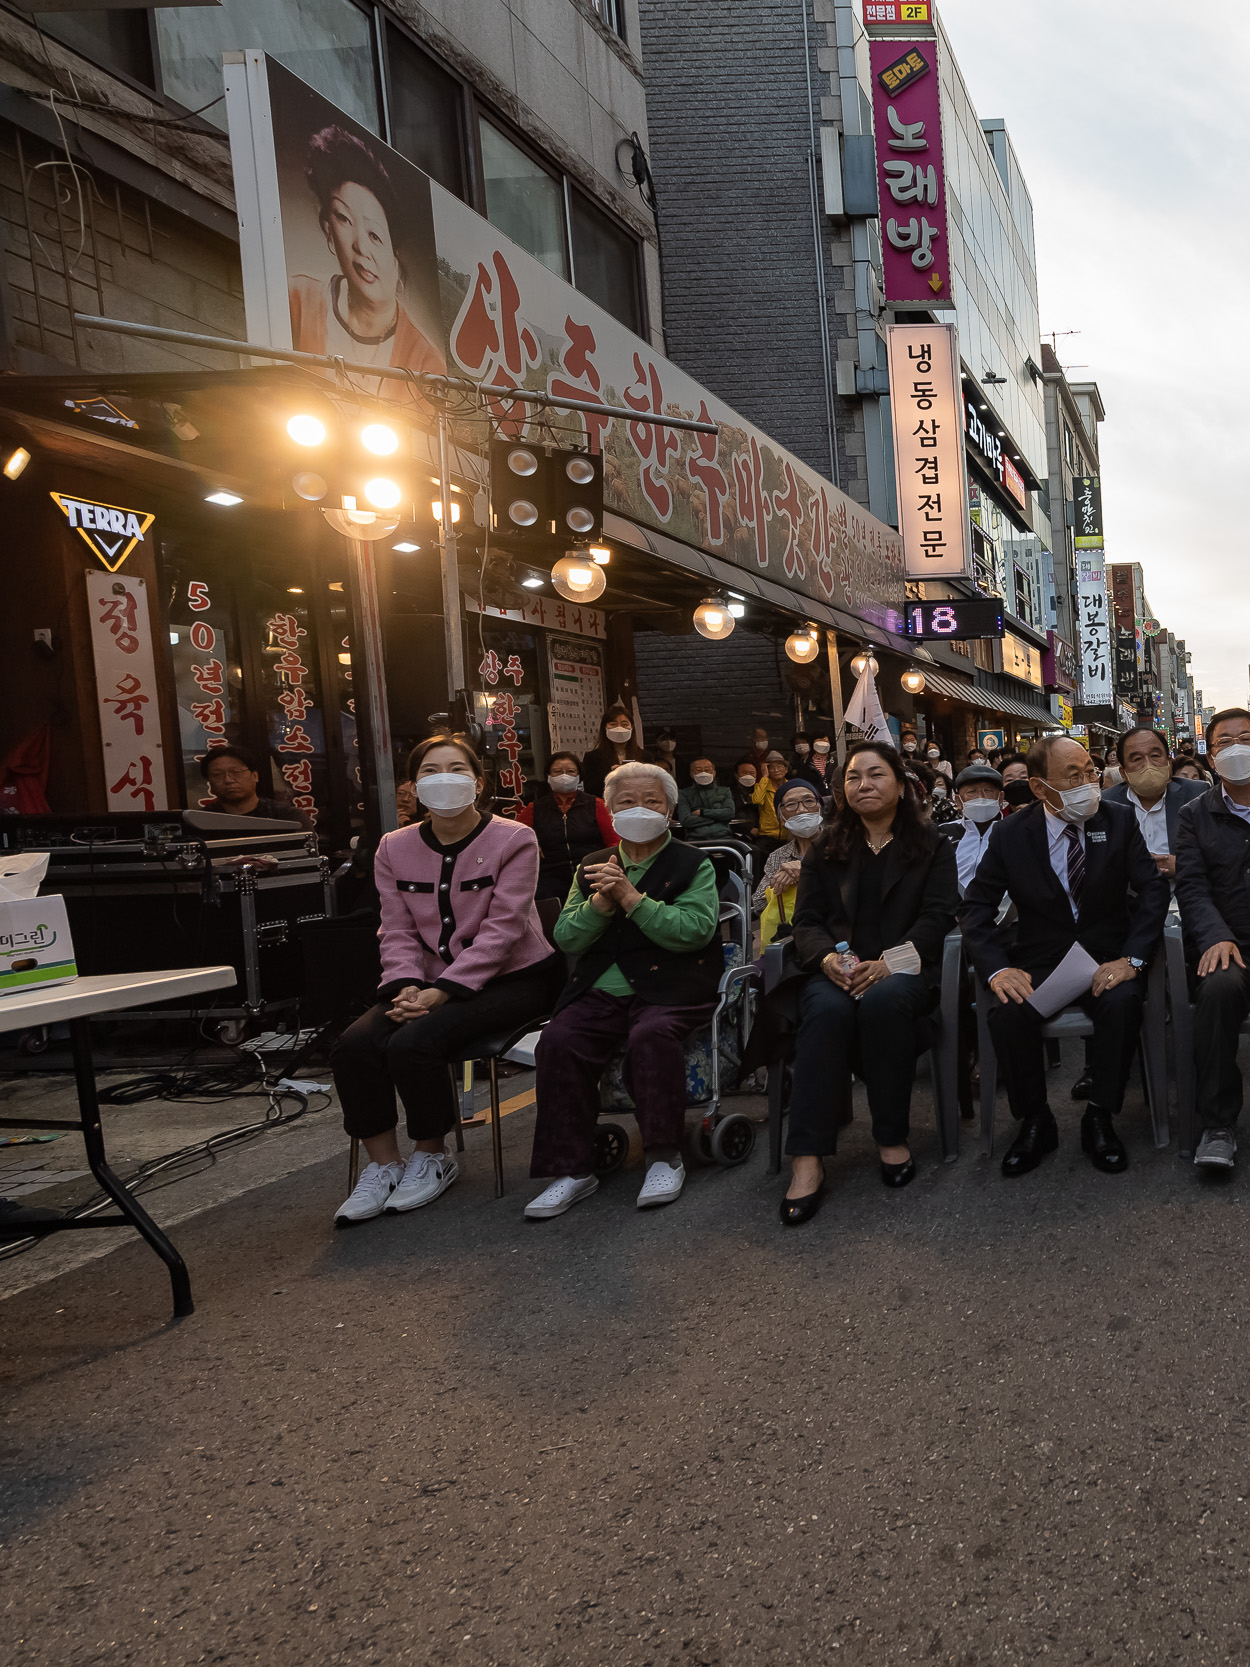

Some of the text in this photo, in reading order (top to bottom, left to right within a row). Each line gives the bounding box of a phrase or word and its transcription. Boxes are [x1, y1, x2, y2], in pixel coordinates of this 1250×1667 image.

[866, 5, 922, 20] 전문점 2F
[881, 52, 925, 89] 토마토
[882, 104, 938, 271] 노래방
[906, 343, 948, 558] 냉동삼겹전문
[61, 498, 145, 541] TERRA
[912, 606, 958, 634] 18
[1081, 594, 1106, 681] 대봉갈비
[479, 649, 525, 688] 상주
[266, 613, 318, 826] 한우암소전문
